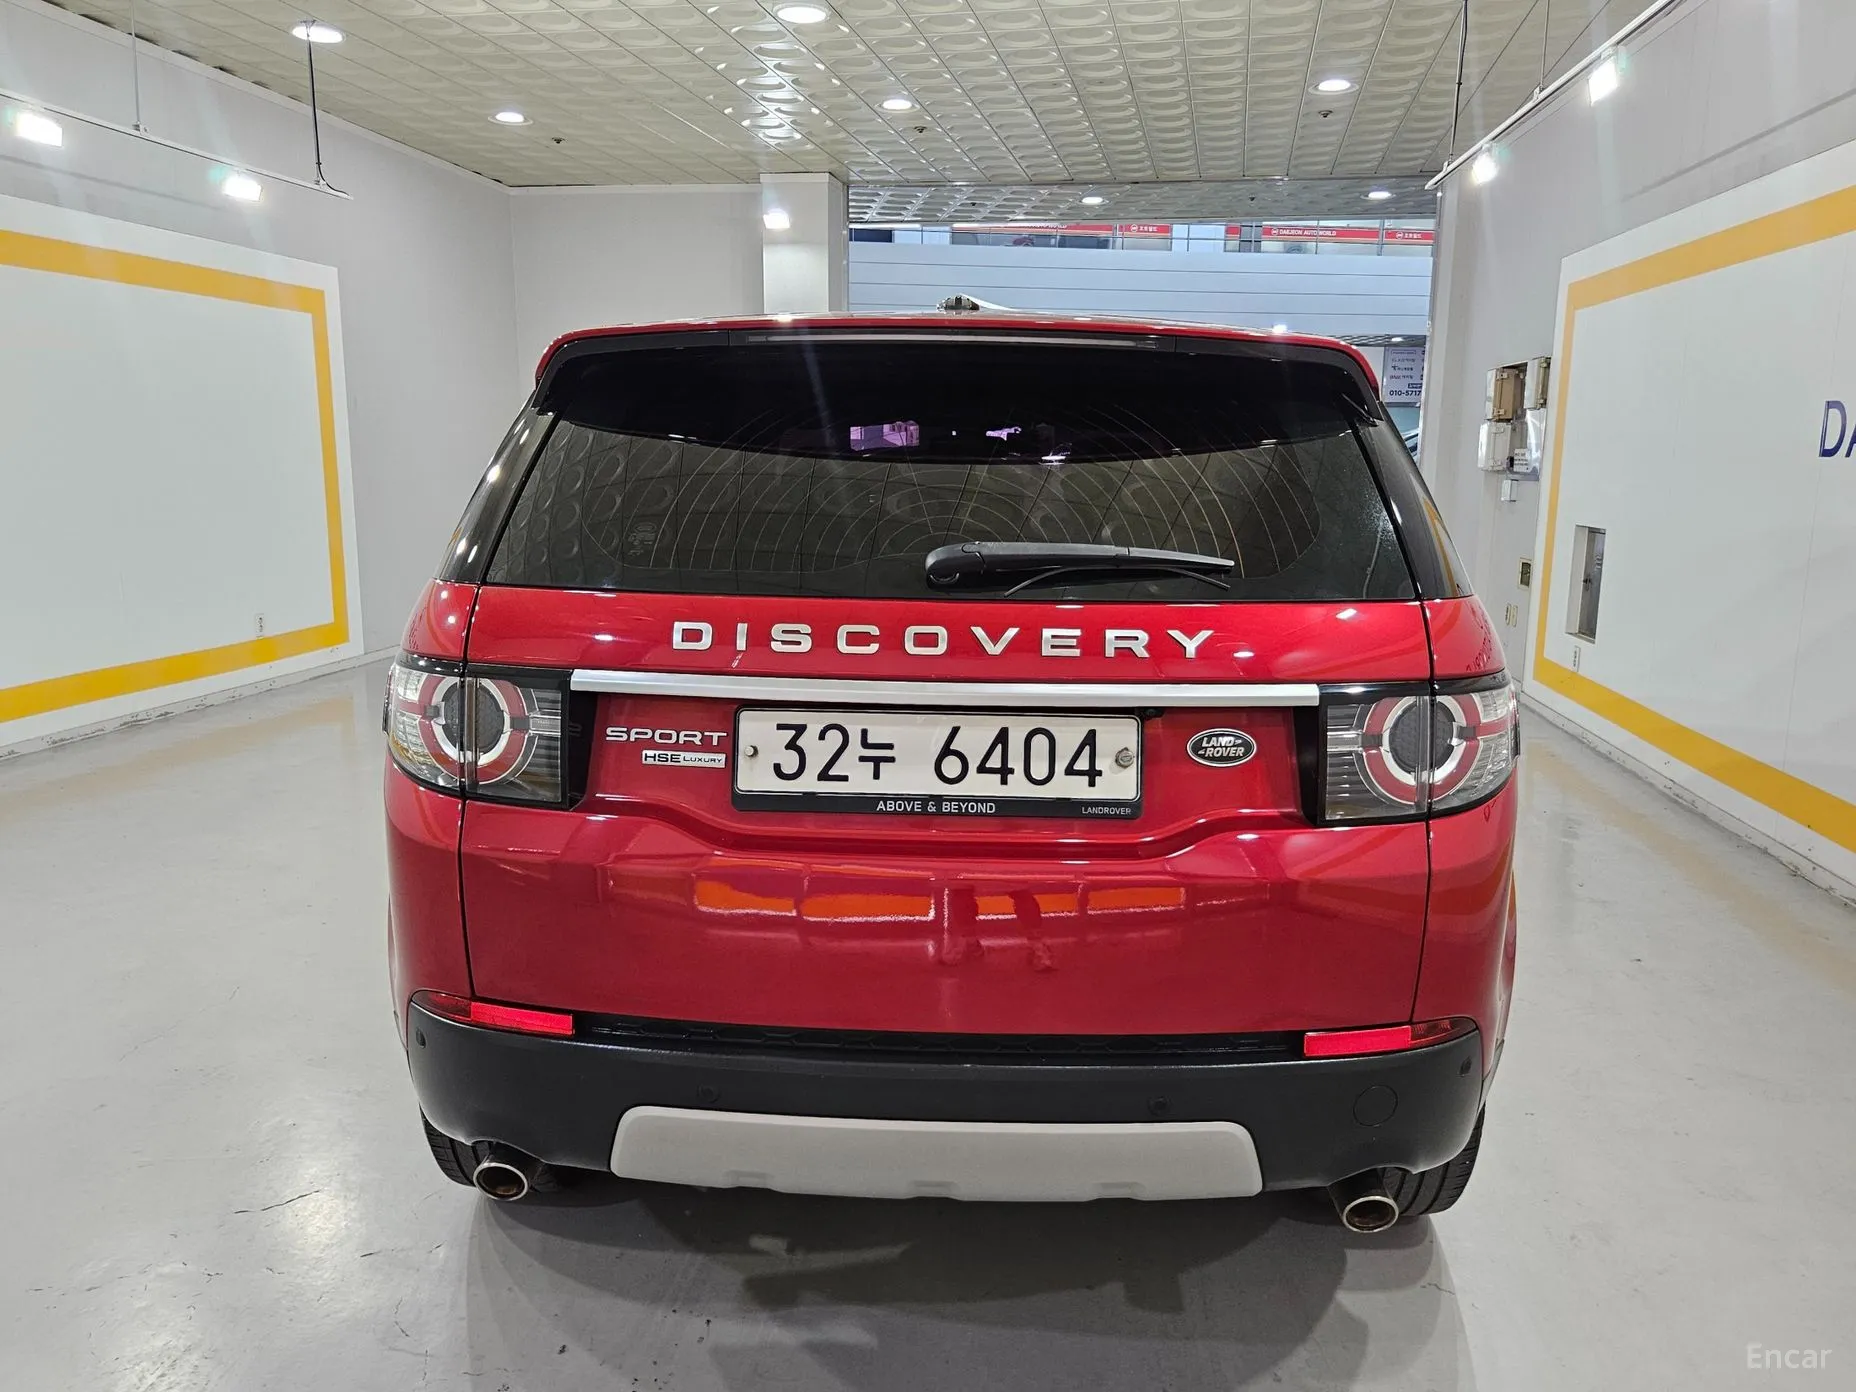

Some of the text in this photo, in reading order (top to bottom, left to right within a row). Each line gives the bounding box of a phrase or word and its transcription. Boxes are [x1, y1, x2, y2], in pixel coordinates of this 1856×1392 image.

[672, 621, 1214, 660] DISCOVERY
[605, 727, 727, 746] SPORT
[1201, 736, 1235, 747] LAND
[644, 752, 681, 763] HSE
[773, 723, 1103, 788] 32누 6404
[1205, 747, 1245, 757] ROVER
[876, 800, 996, 814] ABOVE & BEYOND
[1081, 806, 1131, 816] LANDROVER
